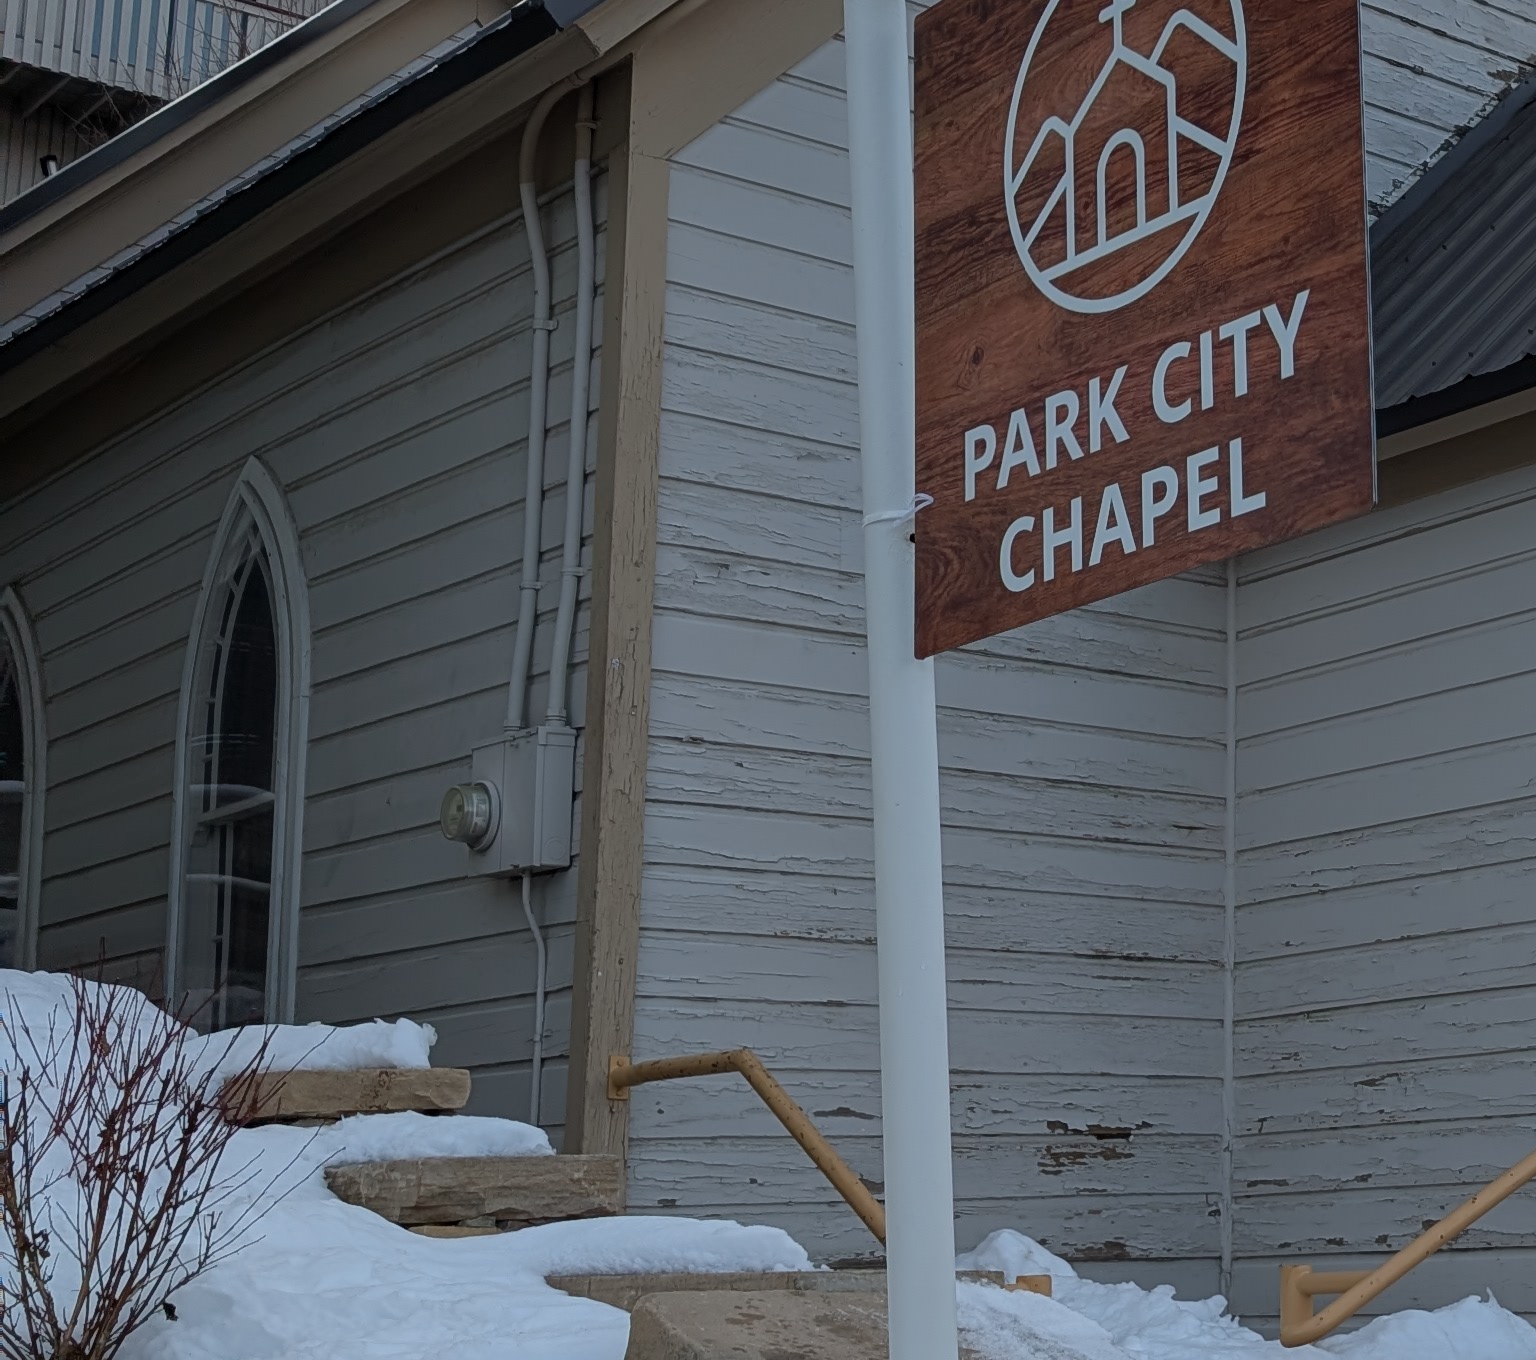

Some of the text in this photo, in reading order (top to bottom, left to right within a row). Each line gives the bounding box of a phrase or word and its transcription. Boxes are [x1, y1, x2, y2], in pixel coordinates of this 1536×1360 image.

[964, 289, 1310, 502] PARK CITY
[1000, 437, 1266, 593] CHAPEL
